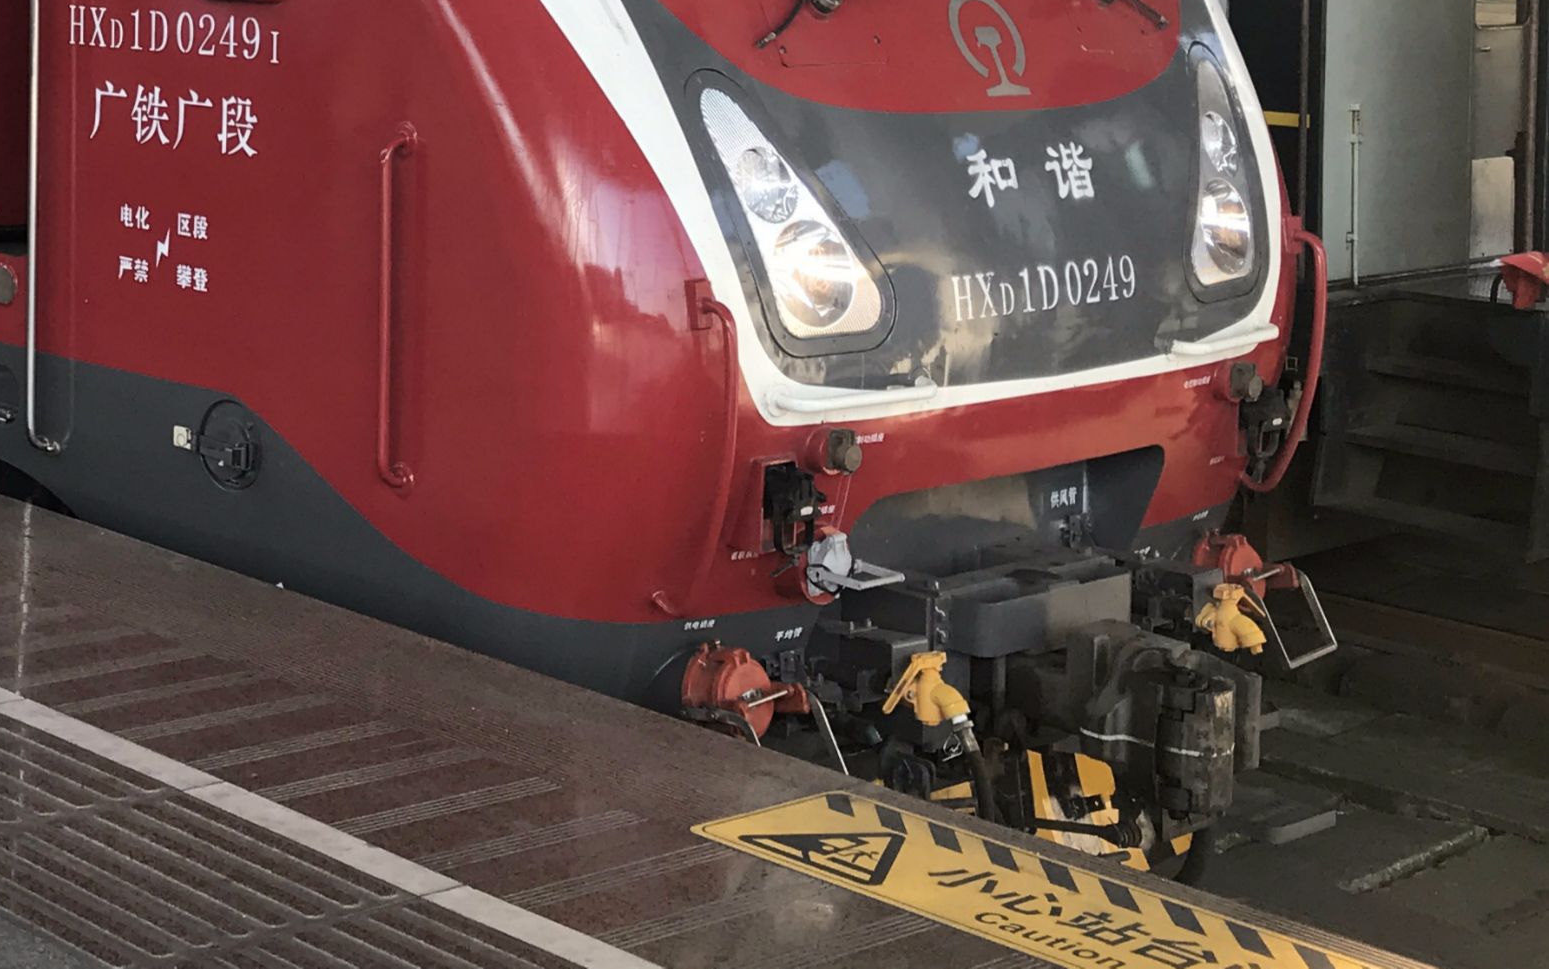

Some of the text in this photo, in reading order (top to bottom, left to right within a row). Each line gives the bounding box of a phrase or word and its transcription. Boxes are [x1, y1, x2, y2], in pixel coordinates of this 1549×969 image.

[90, 80, 258, 158] 广铁广段
[966, 141, 1095, 208] 和谐
[120, 203, 208, 240] 电化 区段
[118, 255, 208, 292] 严禁 攀登
[928, 868, 1262, 969] 小心站台
[974, 912, 1126, 969] Caution
